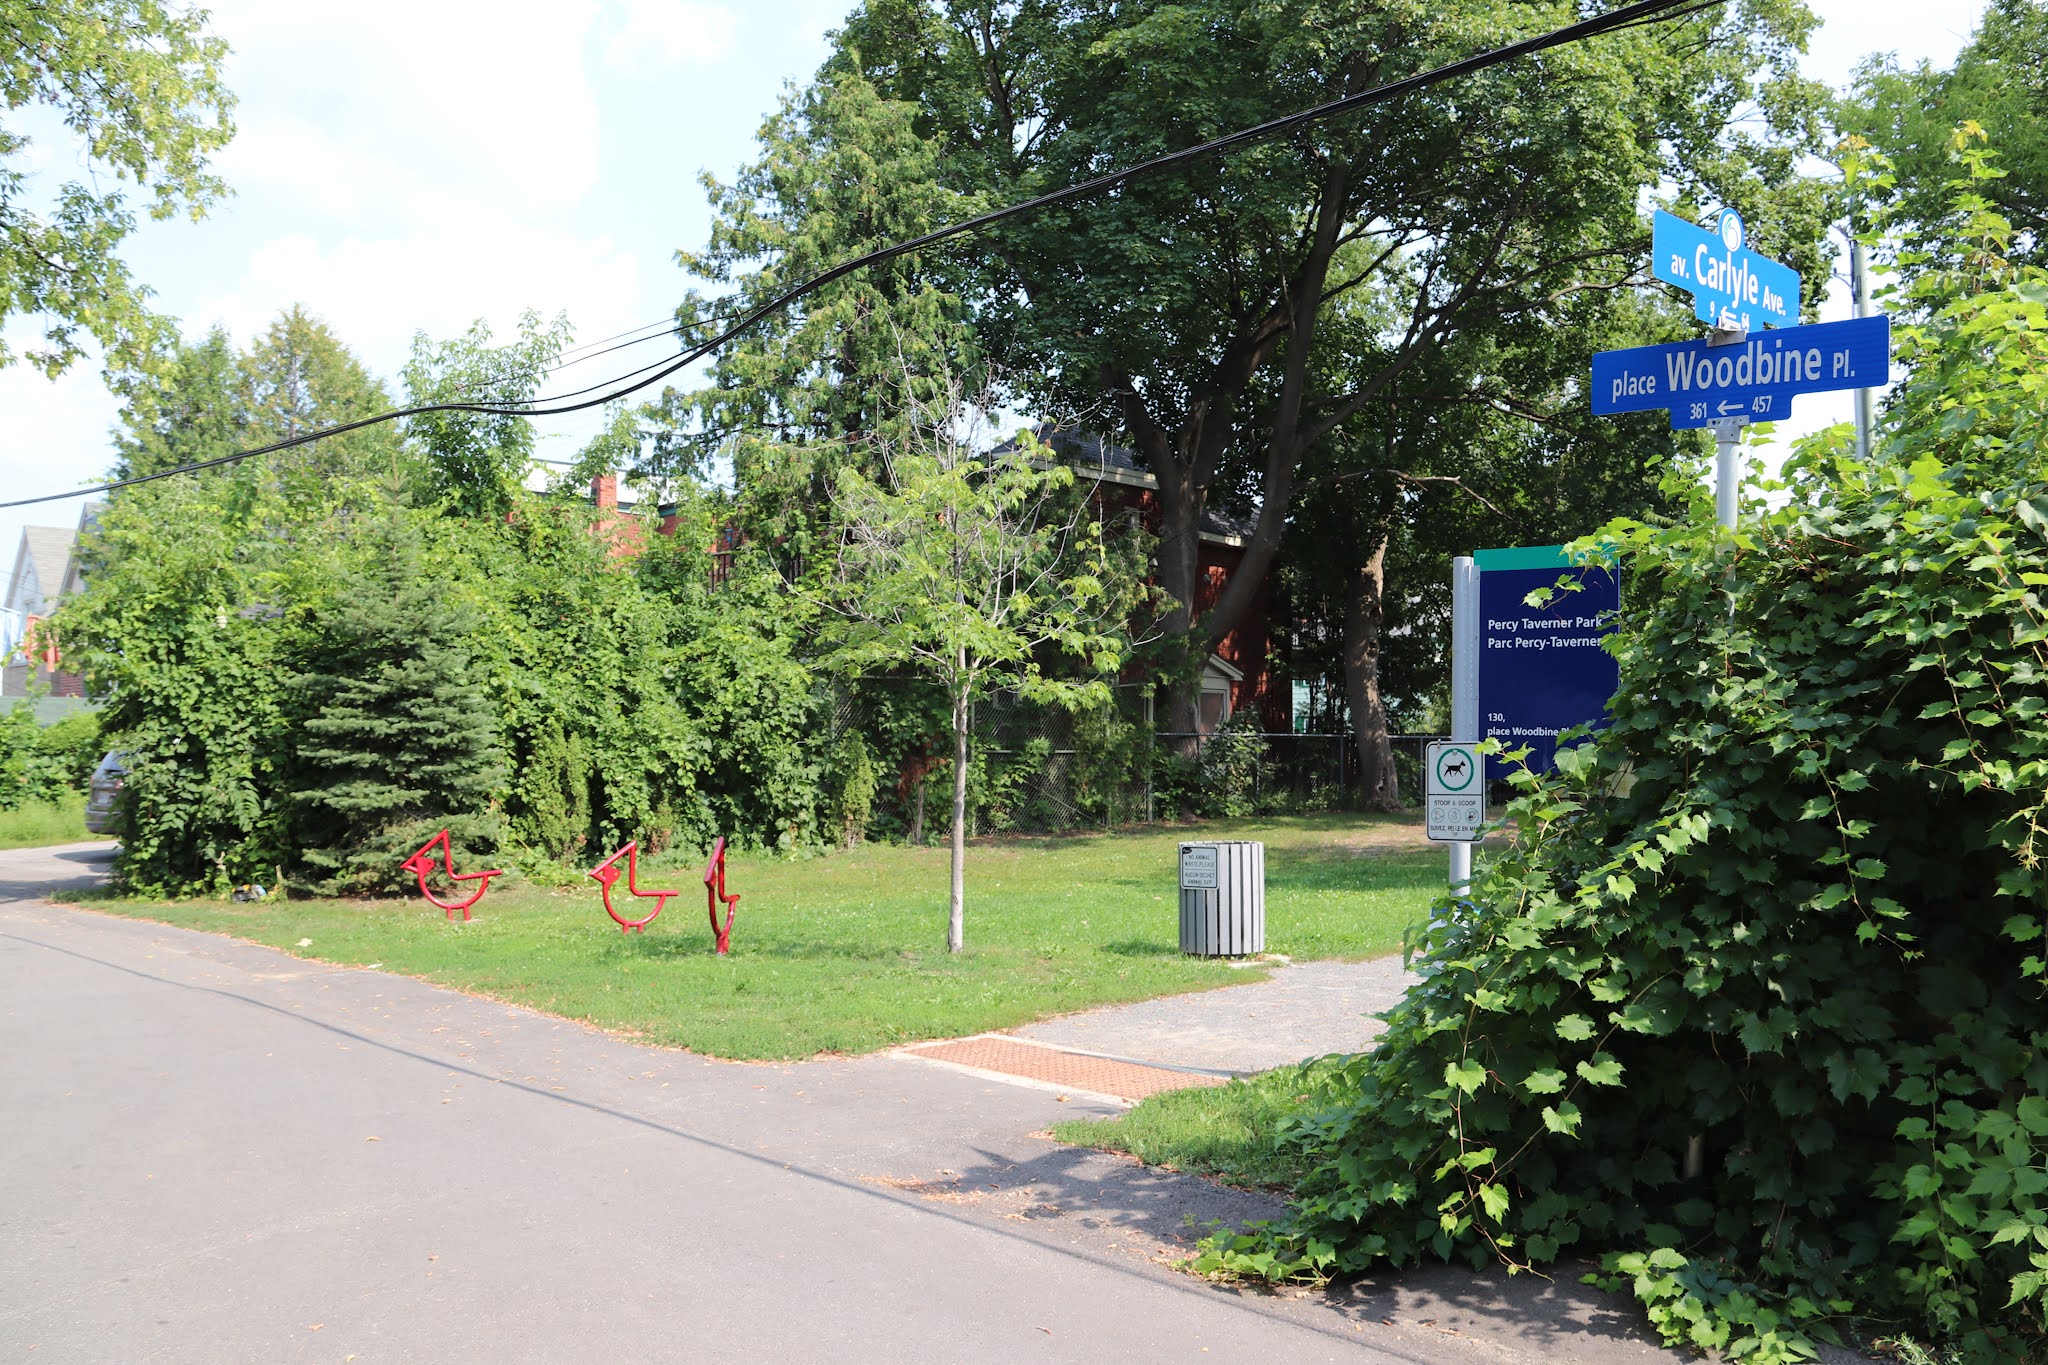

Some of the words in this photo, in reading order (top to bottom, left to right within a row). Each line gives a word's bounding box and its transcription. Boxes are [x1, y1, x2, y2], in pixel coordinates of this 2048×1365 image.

[1671, 253, 1689, 279] av.
[1695, 244, 1758, 308] Carlyle
[1762, 286, 1786, 316] Ave.
[1710, 300, 1715, 318] 9
[1741, 312, 1750, 330] 64
[1612, 371, 1656, 403] place
[1666, 340, 1822, 391] Woodbine
[1832, 349, 1855, 379] Pl.
[1690, 402, 1707, 420] 361
[1752, 395, 1772, 413] 457
[1488, 619, 1519, 632] Percy
[1521, 618, 1573, 629] Taverner
[1576, 616, 1602, 628] Park
[1488, 638, 1512, 648] Parc
[1487, 713, 1505, 722] 130,
[1487, 726, 1510, 737] place
[1512, 726, 1559, 736] Woodbine
